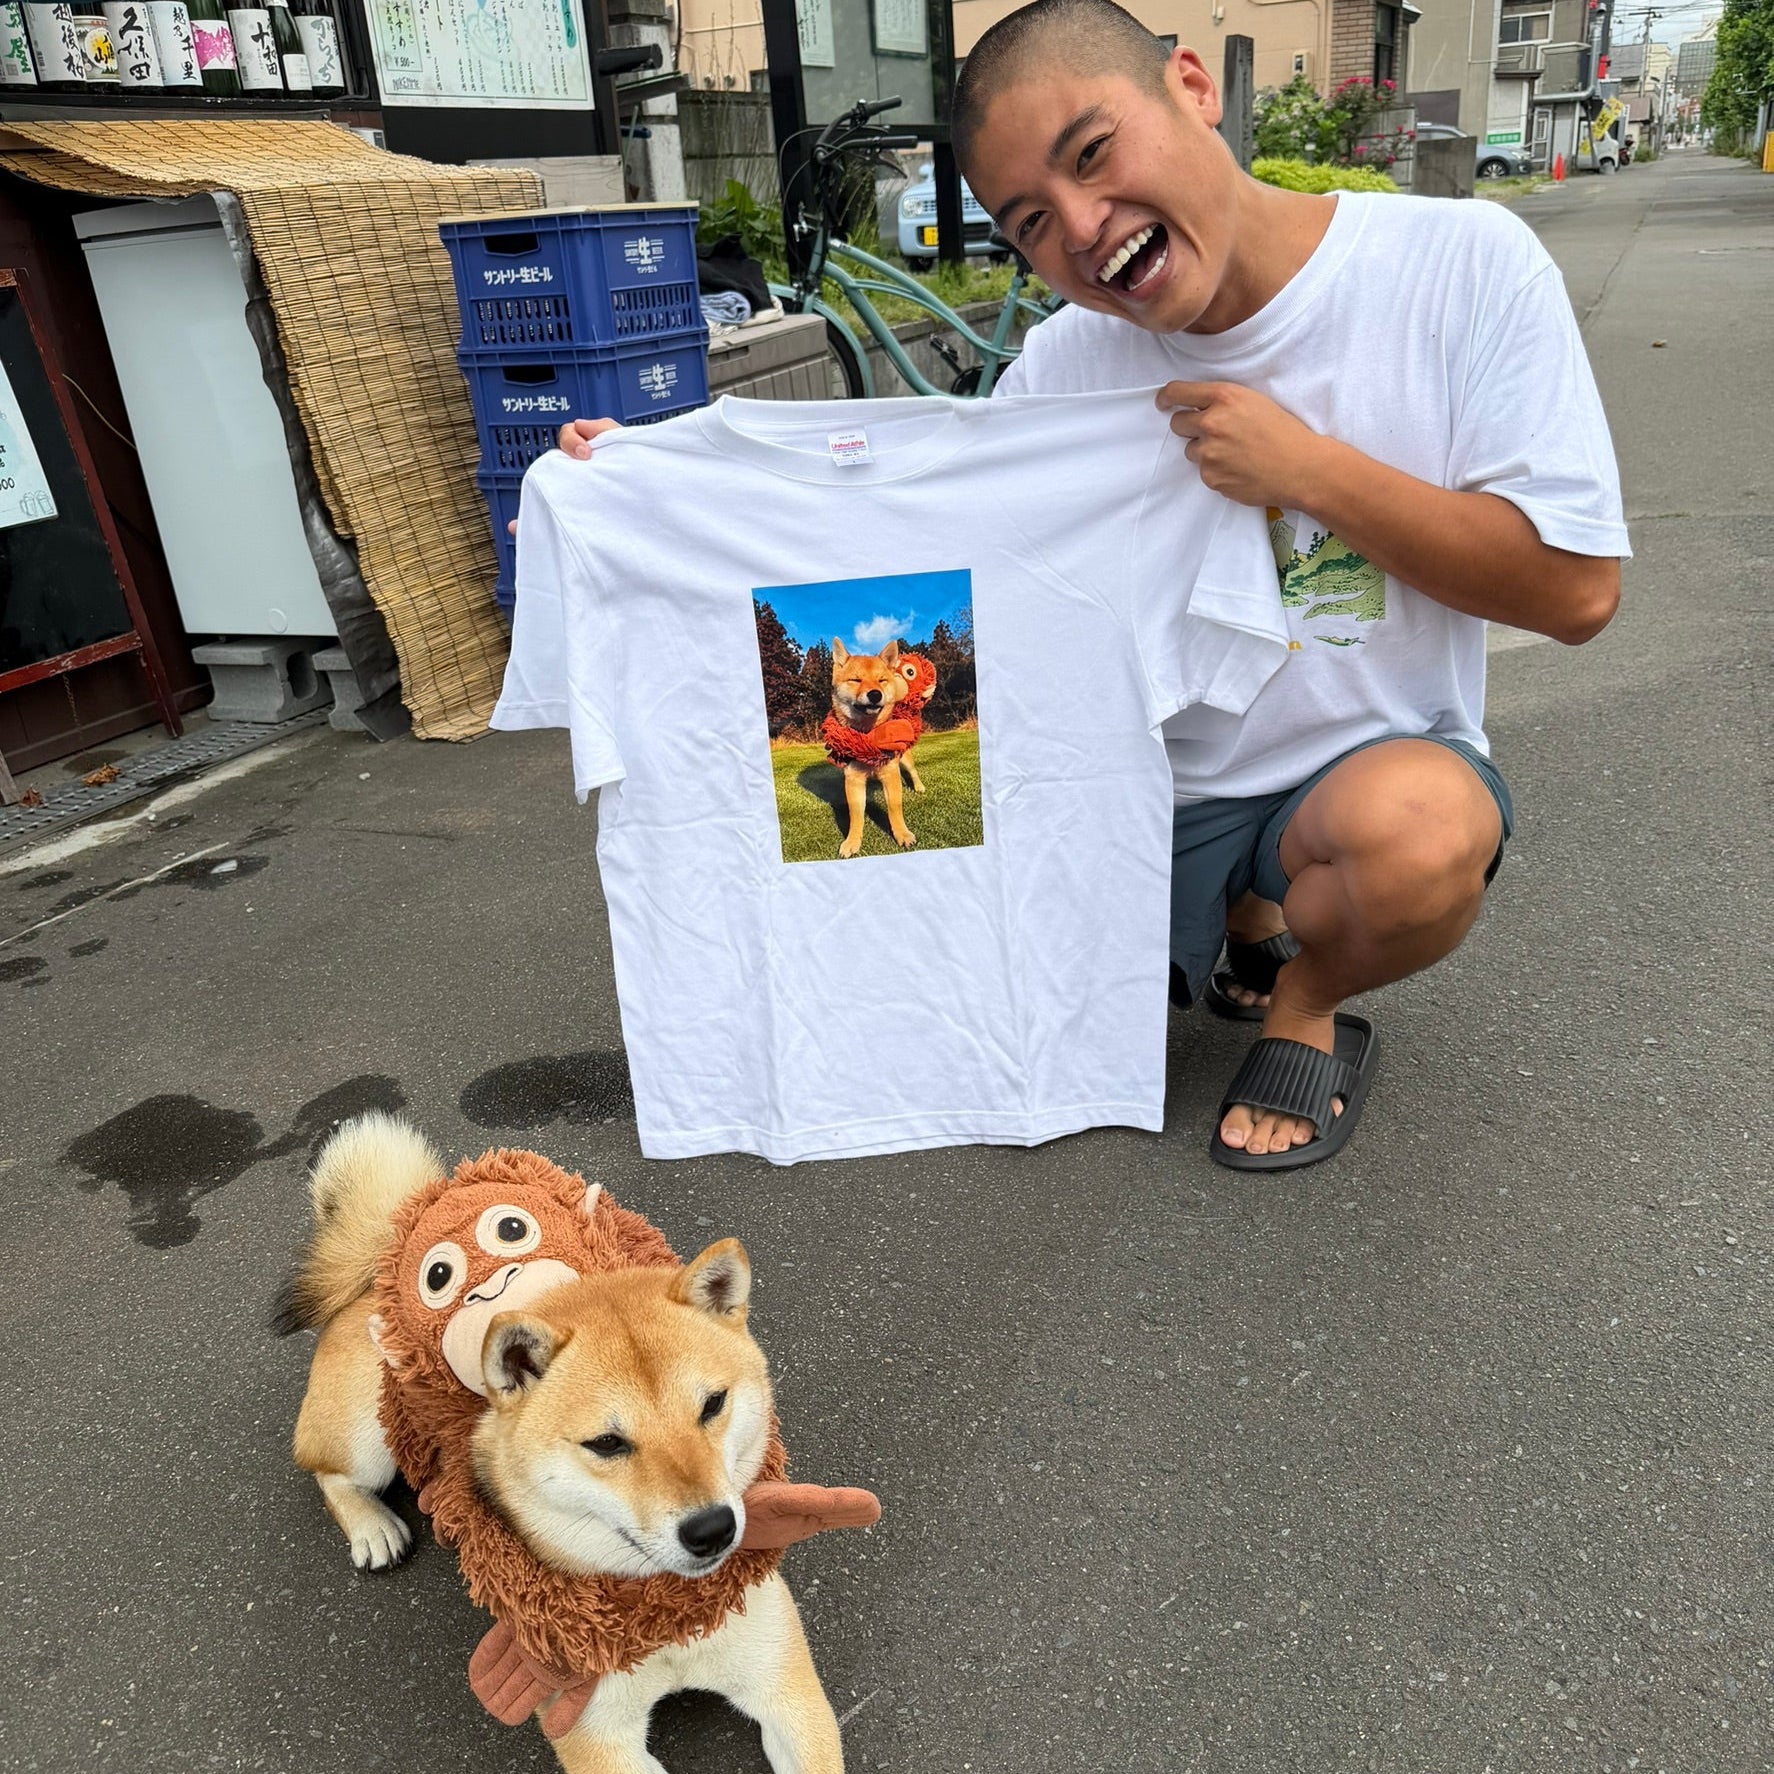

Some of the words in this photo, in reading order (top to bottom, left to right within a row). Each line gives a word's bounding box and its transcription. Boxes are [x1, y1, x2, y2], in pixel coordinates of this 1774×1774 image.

[118, 6, 151, 81] 久保田
[251, 21, 278, 76] 十和田
[484, 266, 553, 285] サントリー生ビール
[502, 395, 571, 412] サントリー生ビール
[0, 477, 15, 491] 00
